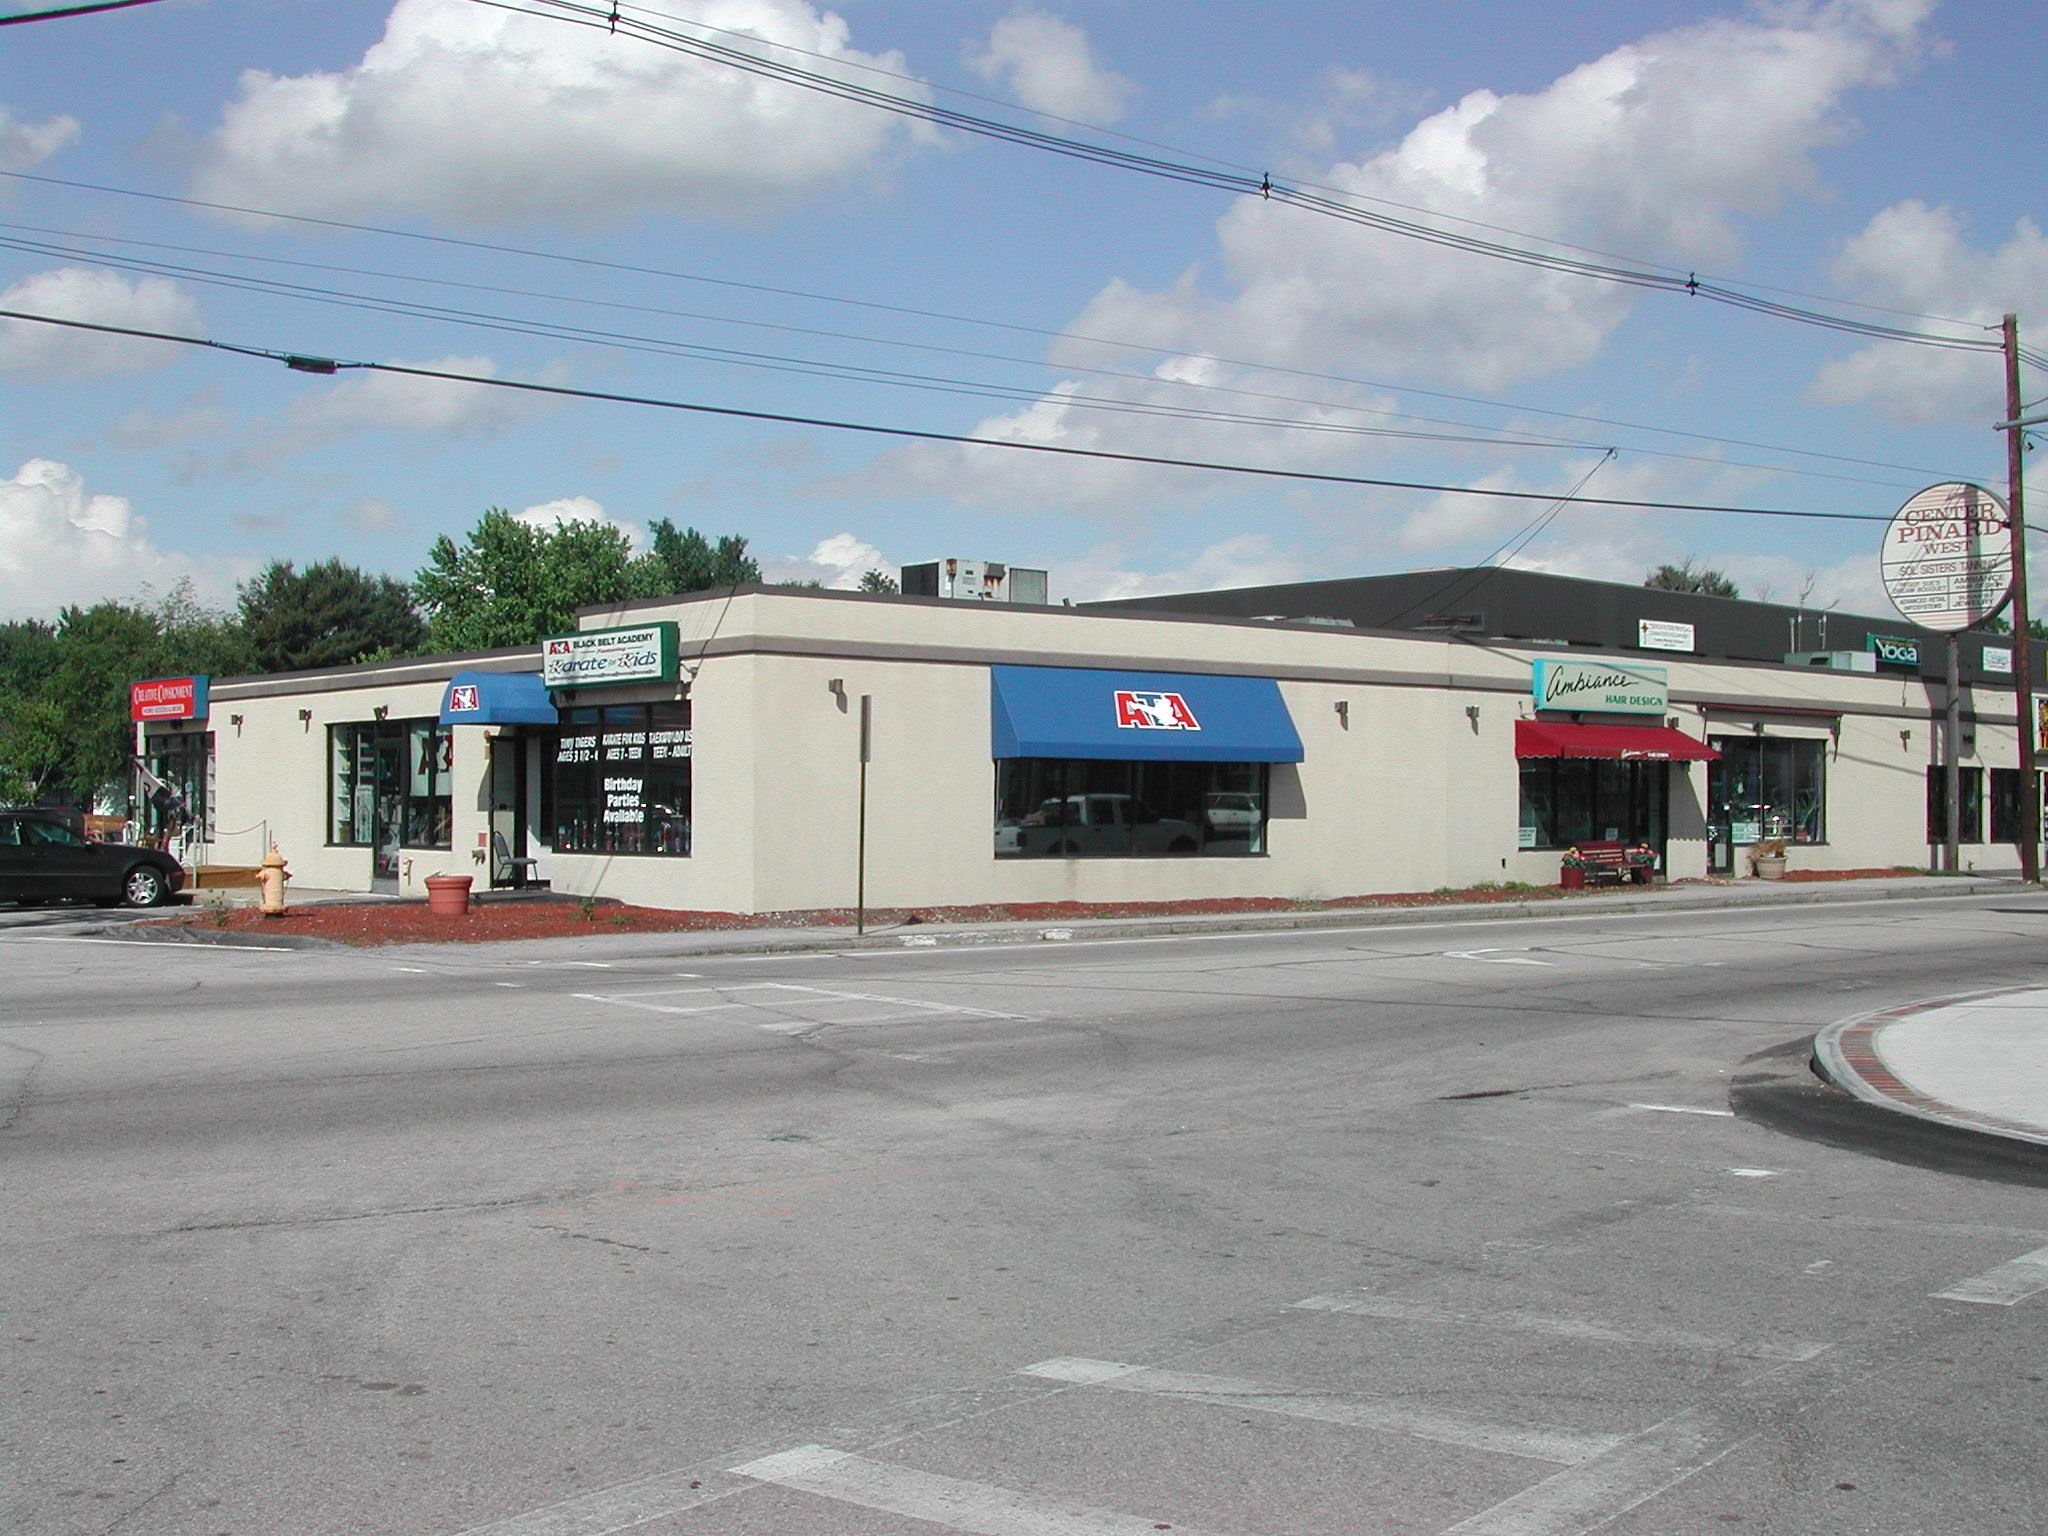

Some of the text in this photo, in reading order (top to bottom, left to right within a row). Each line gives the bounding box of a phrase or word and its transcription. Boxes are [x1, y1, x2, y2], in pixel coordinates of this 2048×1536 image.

[1906, 503, 1996, 526] CENTER
[1898, 520, 2002, 543] PINARD
[1924, 540, 1973, 555] WEST
[1920, 562, 1957, 574] SISTERS
[1960, 559, 1997, 572] TANNING
[1954, 573, 2005, 584] AMBIANCE
[573, 639, 596, 649] BLACK
[597, 637, 615, 647] BELT
[617, 633, 654, 644] ACADEMY
[549, 656, 608, 674] Karate
[618, 651, 657, 670] Kids
[1605, 694, 1663, 706] HAIR DESIGN
[1114, 690, 1201, 731] ATA
[604, 777, 643, 794] Birthday
[607, 793, 640, 807] Parties
[603, 809, 645, 823] Available
